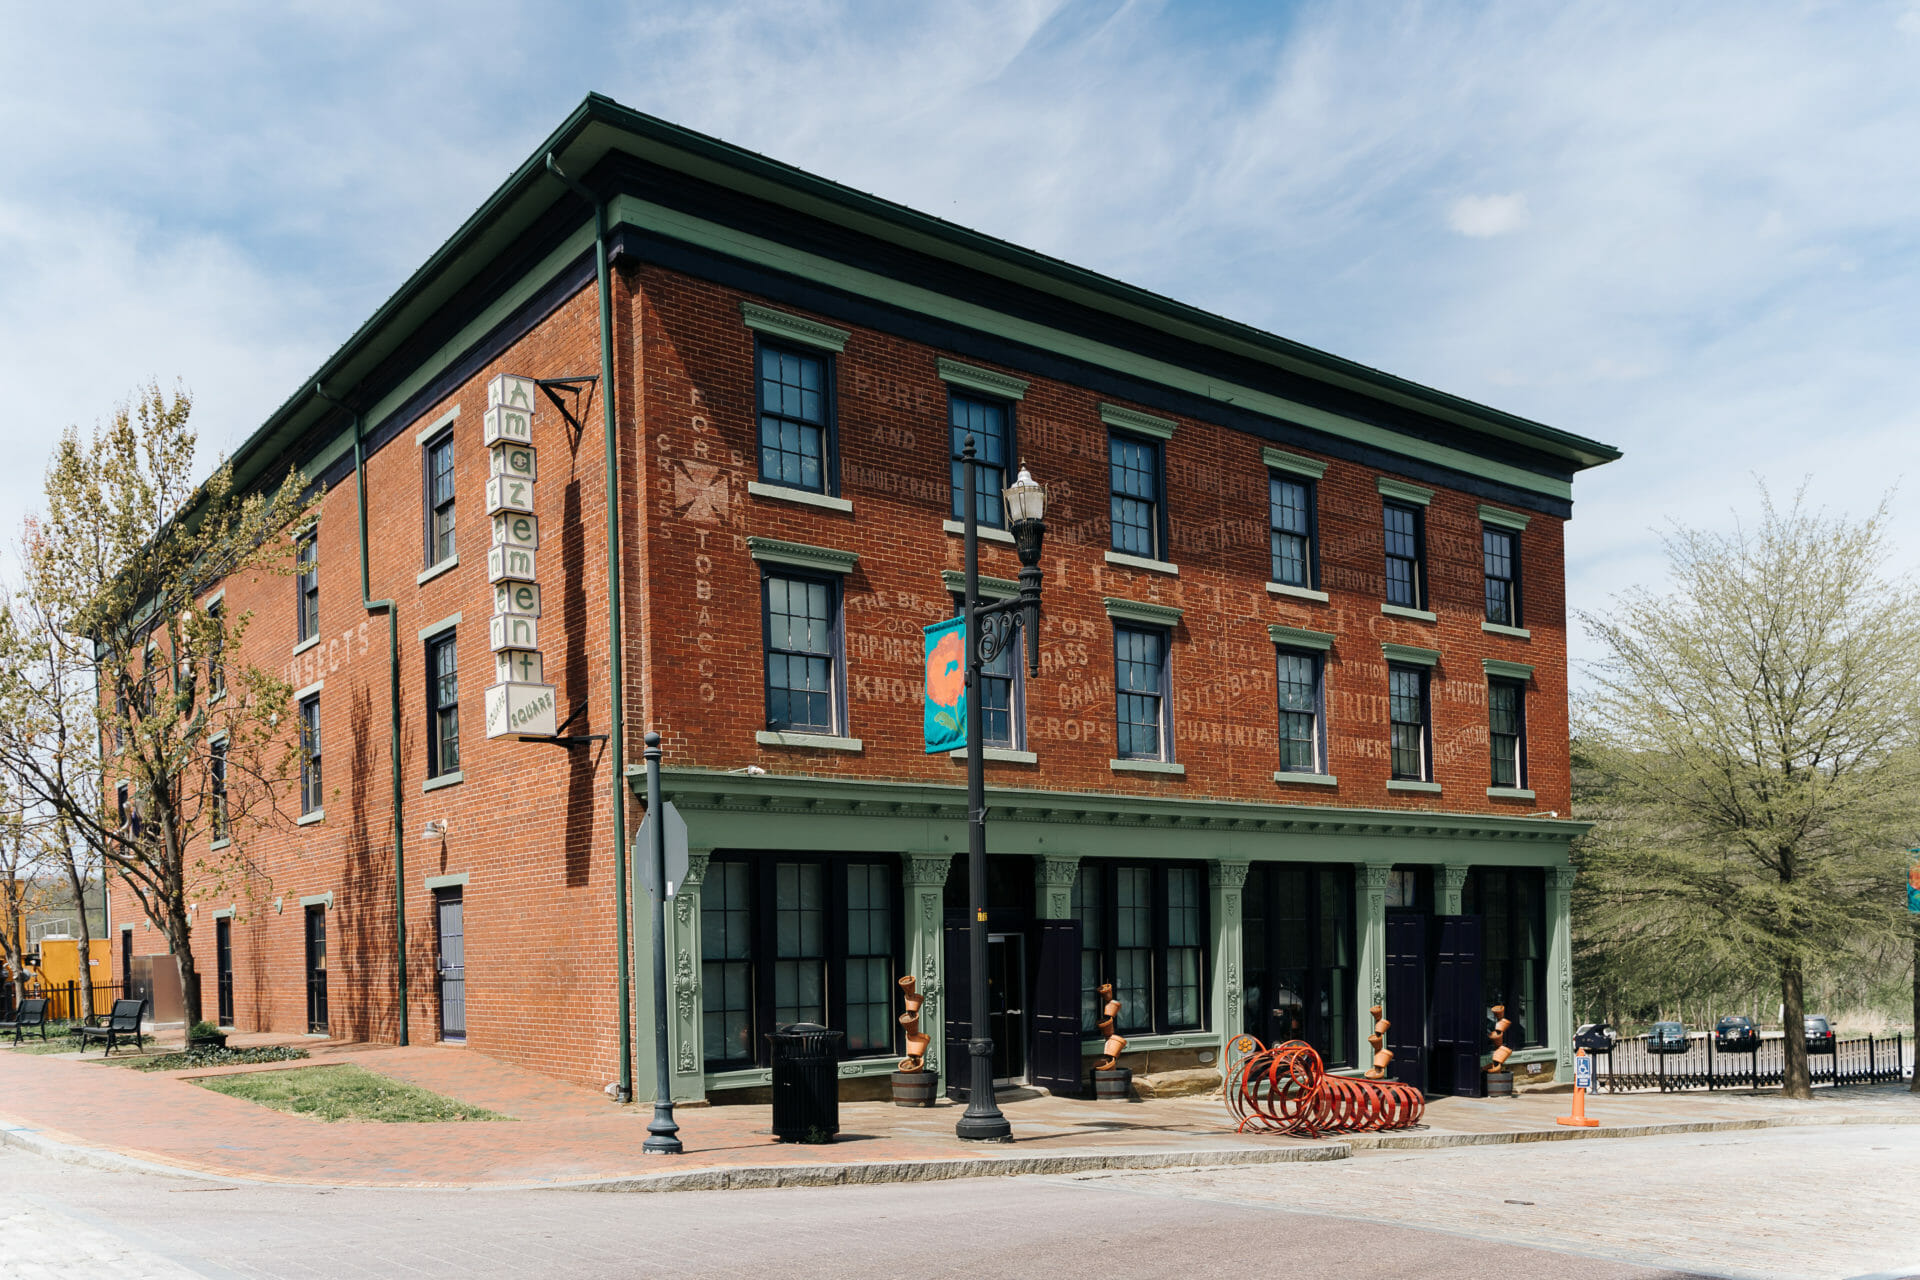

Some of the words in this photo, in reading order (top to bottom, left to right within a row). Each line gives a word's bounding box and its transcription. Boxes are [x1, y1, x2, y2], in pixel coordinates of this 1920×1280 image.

[855, 370, 928, 414] PURE
[690, 387, 708, 458] FOR
[871, 423, 916, 450] AND
[656, 433, 672, 540] CROSS
[1167, 514, 1264, 557] VEGETATION
[694, 528, 715, 704] TOBACCO
[849, 591, 889, 613] THE
[897, 591, 953, 620] BEST
[1043, 614, 1096, 639] FOR
[282, 621, 370, 689] INSECTS
[1041, 642, 1088, 676] RASS
[1066, 668, 1082, 681] OR
[1228, 667, 1273, 698] BEST
[509, 692, 552, 727] SQUARE
[1058, 675, 1111, 710] GRAIN
[1327, 689, 1390, 725] FRUIT
[1446, 680, 1486, 706] PERFECT
[1030, 715, 1111, 743] CROPS
